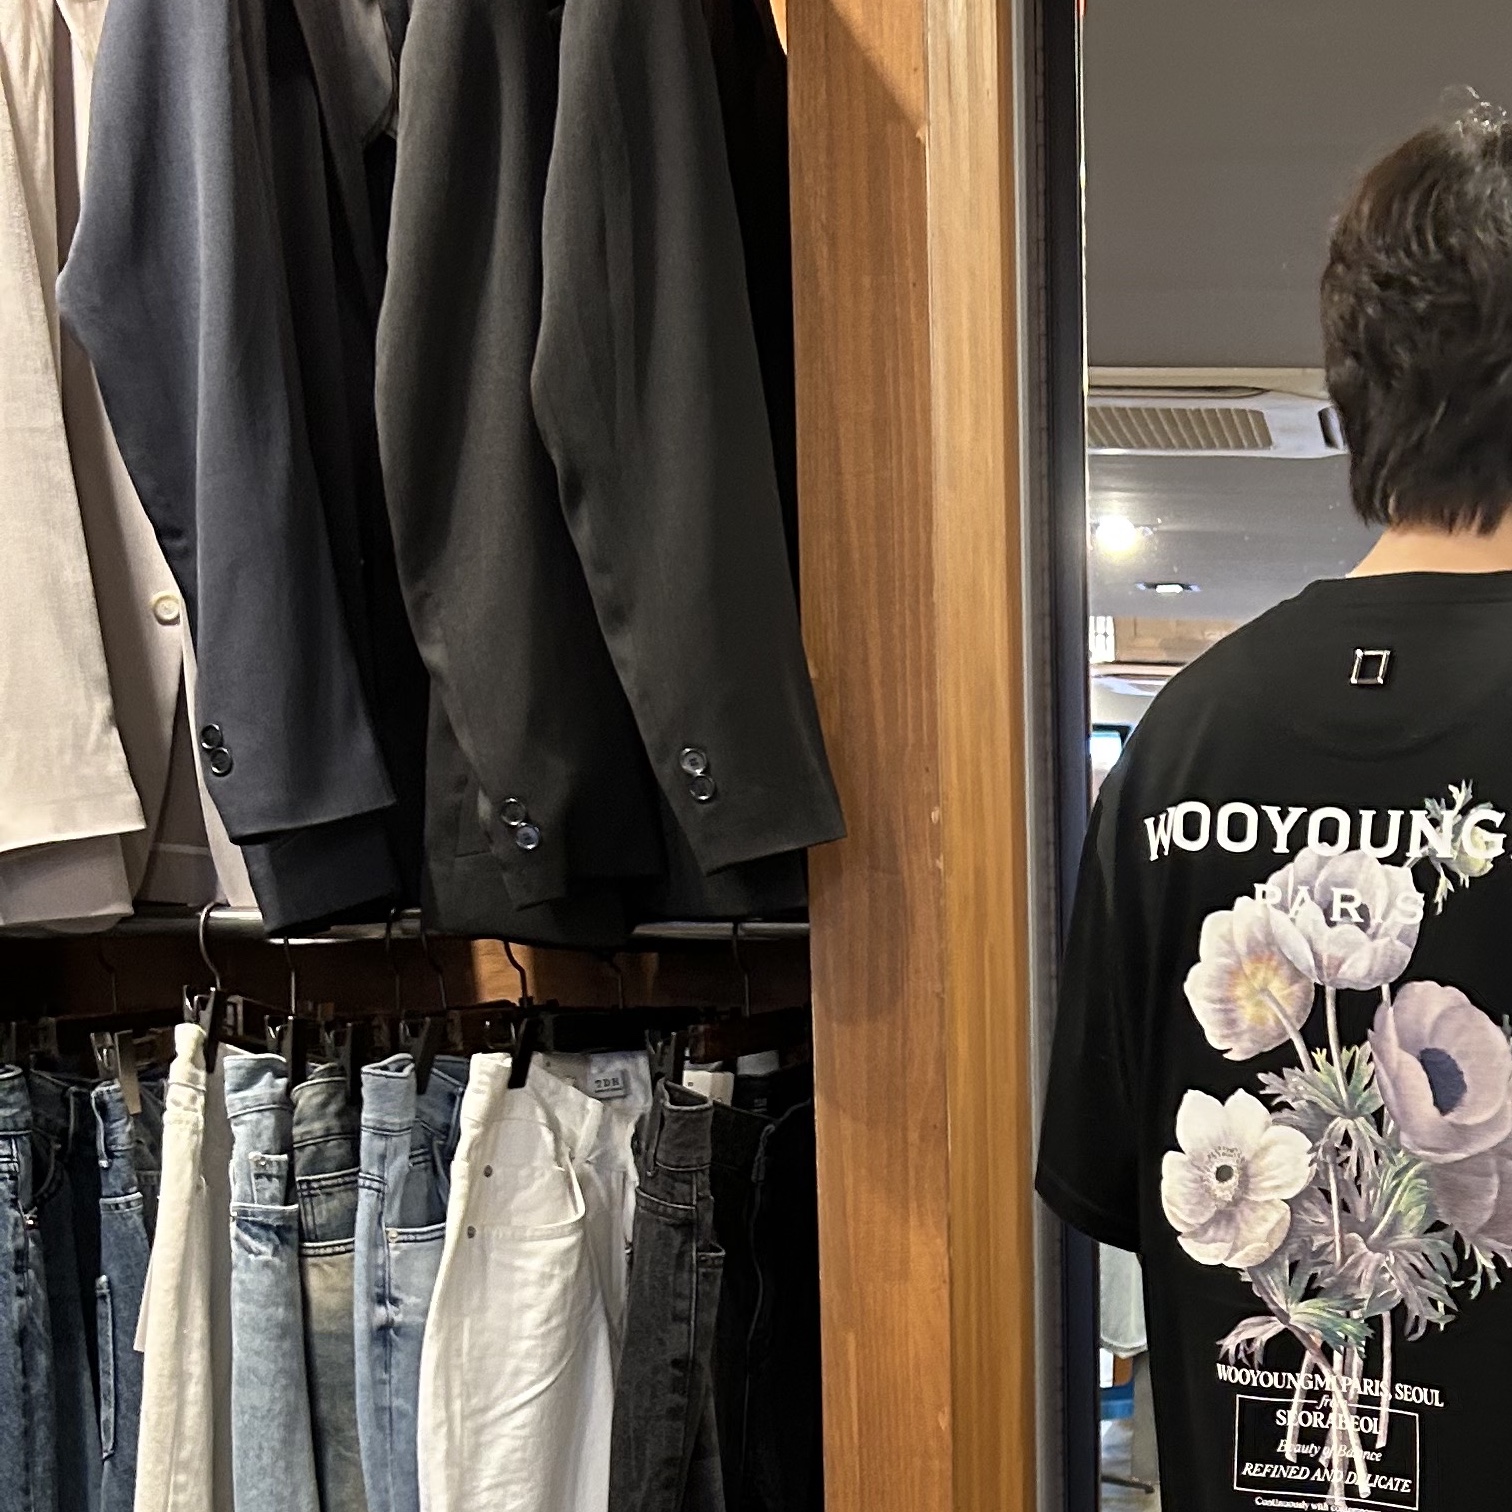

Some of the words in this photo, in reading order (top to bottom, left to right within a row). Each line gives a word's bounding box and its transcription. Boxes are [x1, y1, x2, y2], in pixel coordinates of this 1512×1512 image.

[1395, 1382, 1445, 1408] SEOUL
[1242, 1462, 1311, 1480] REFINED
[1311, 1467, 1344, 1483] AND
